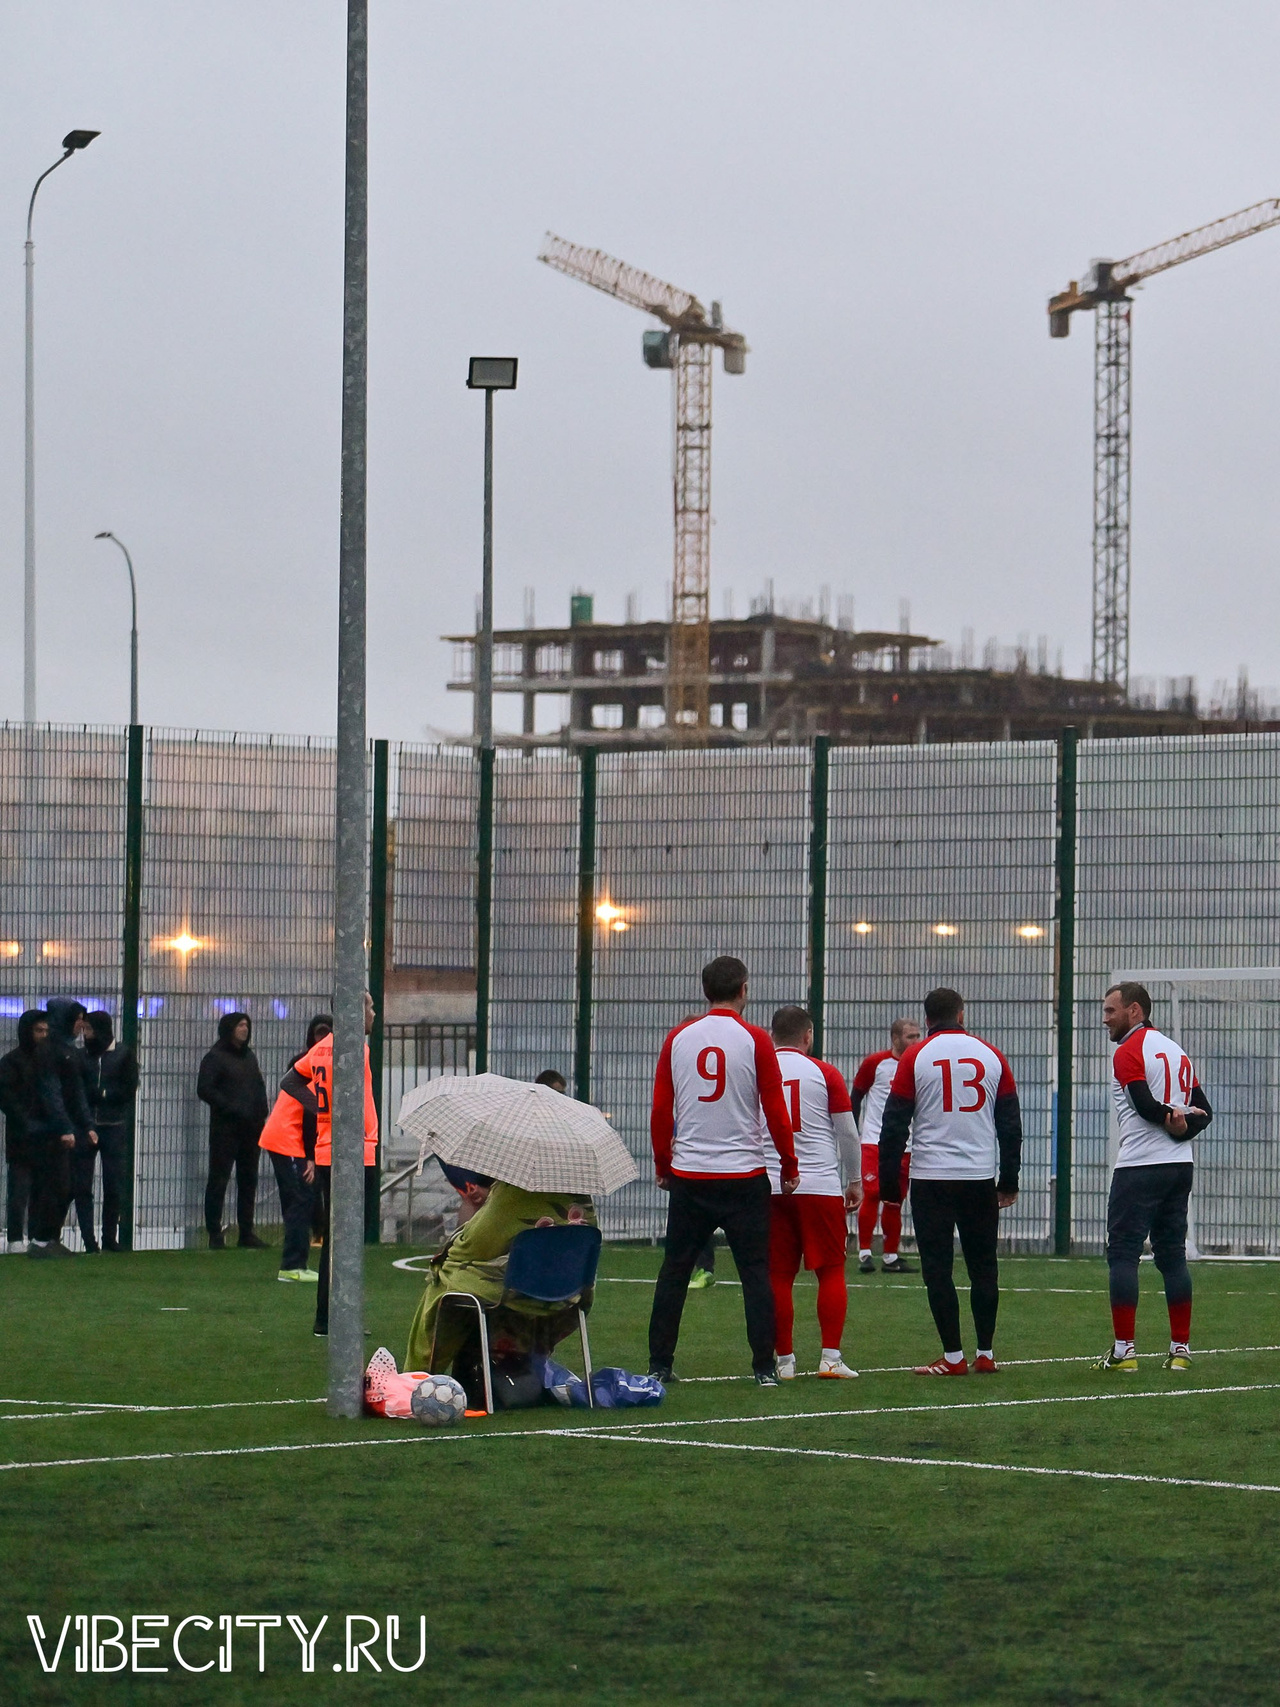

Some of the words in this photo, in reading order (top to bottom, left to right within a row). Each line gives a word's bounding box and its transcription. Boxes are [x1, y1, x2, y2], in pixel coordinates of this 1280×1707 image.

[696, 1046, 727, 1103] 9
[932, 1057, 986, 1113] 13
[1154, 1052, 1192, 1106] 14
